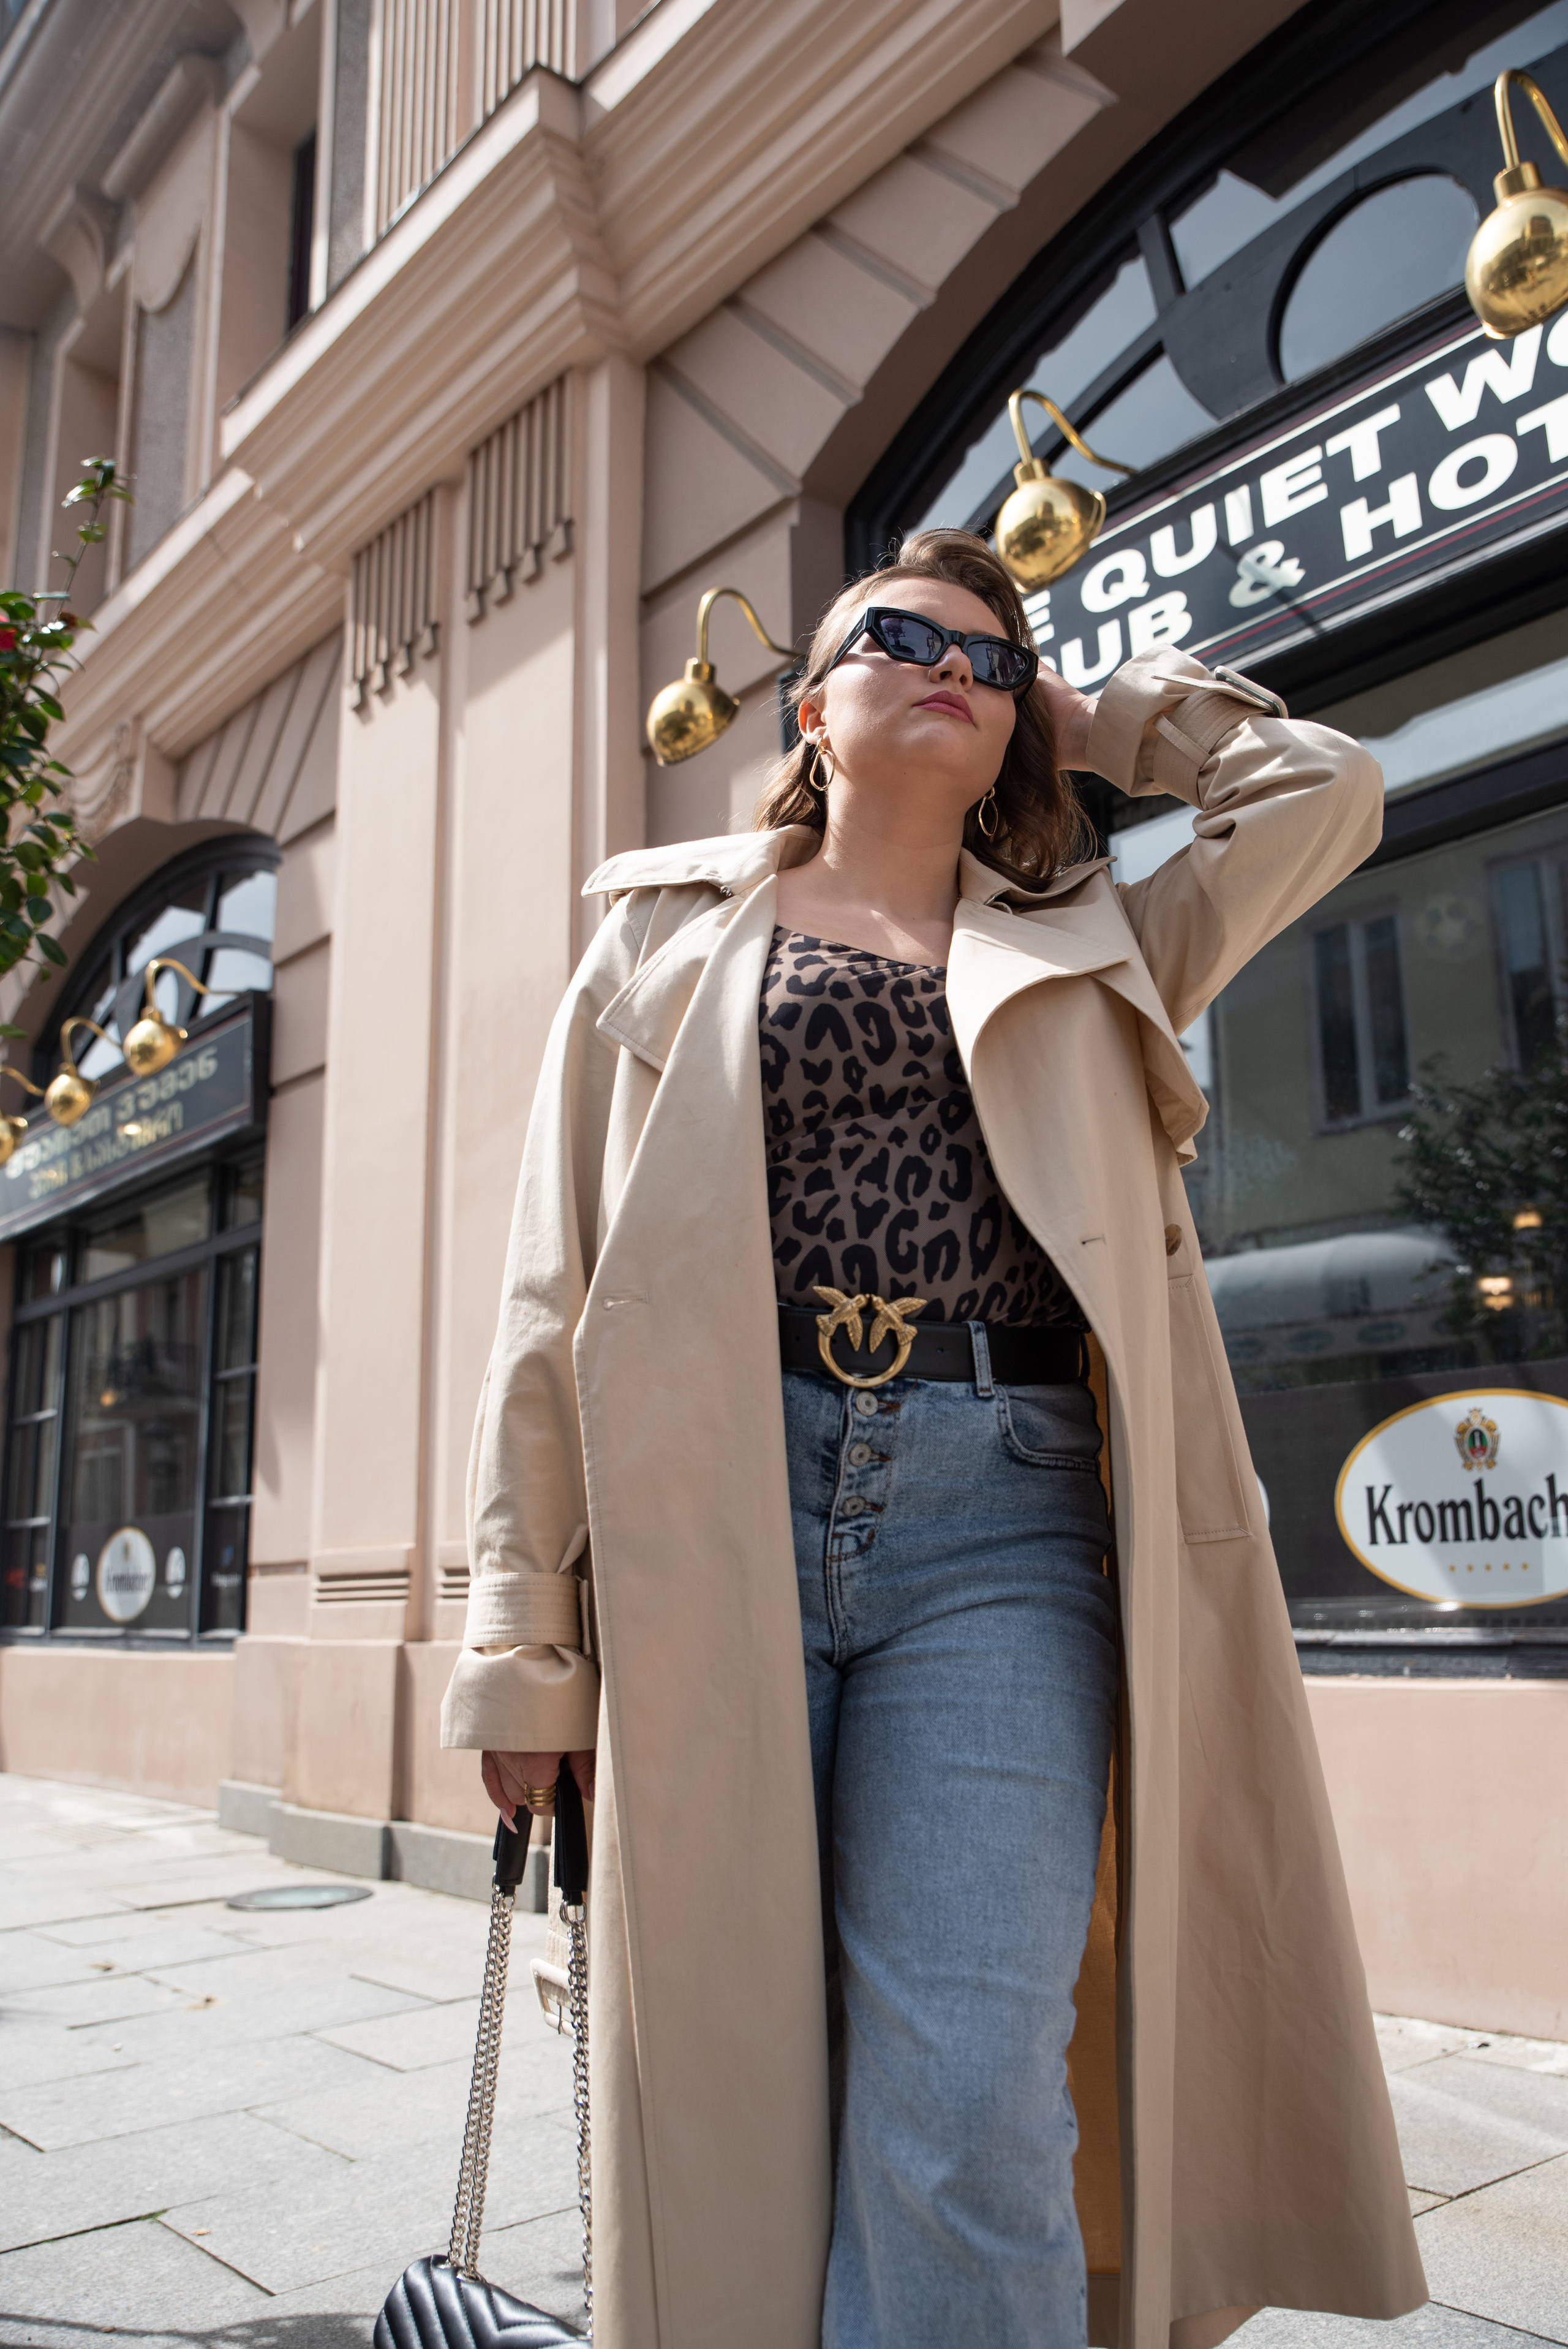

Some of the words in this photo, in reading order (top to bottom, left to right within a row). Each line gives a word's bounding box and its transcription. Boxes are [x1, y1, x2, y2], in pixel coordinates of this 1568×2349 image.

[1080, 403, 1401, 613] QUIET
[1424, 311, 1568, 431] W
[1039, 590, 1193, 688] UB
[1229, 540, 1306, 608] &
